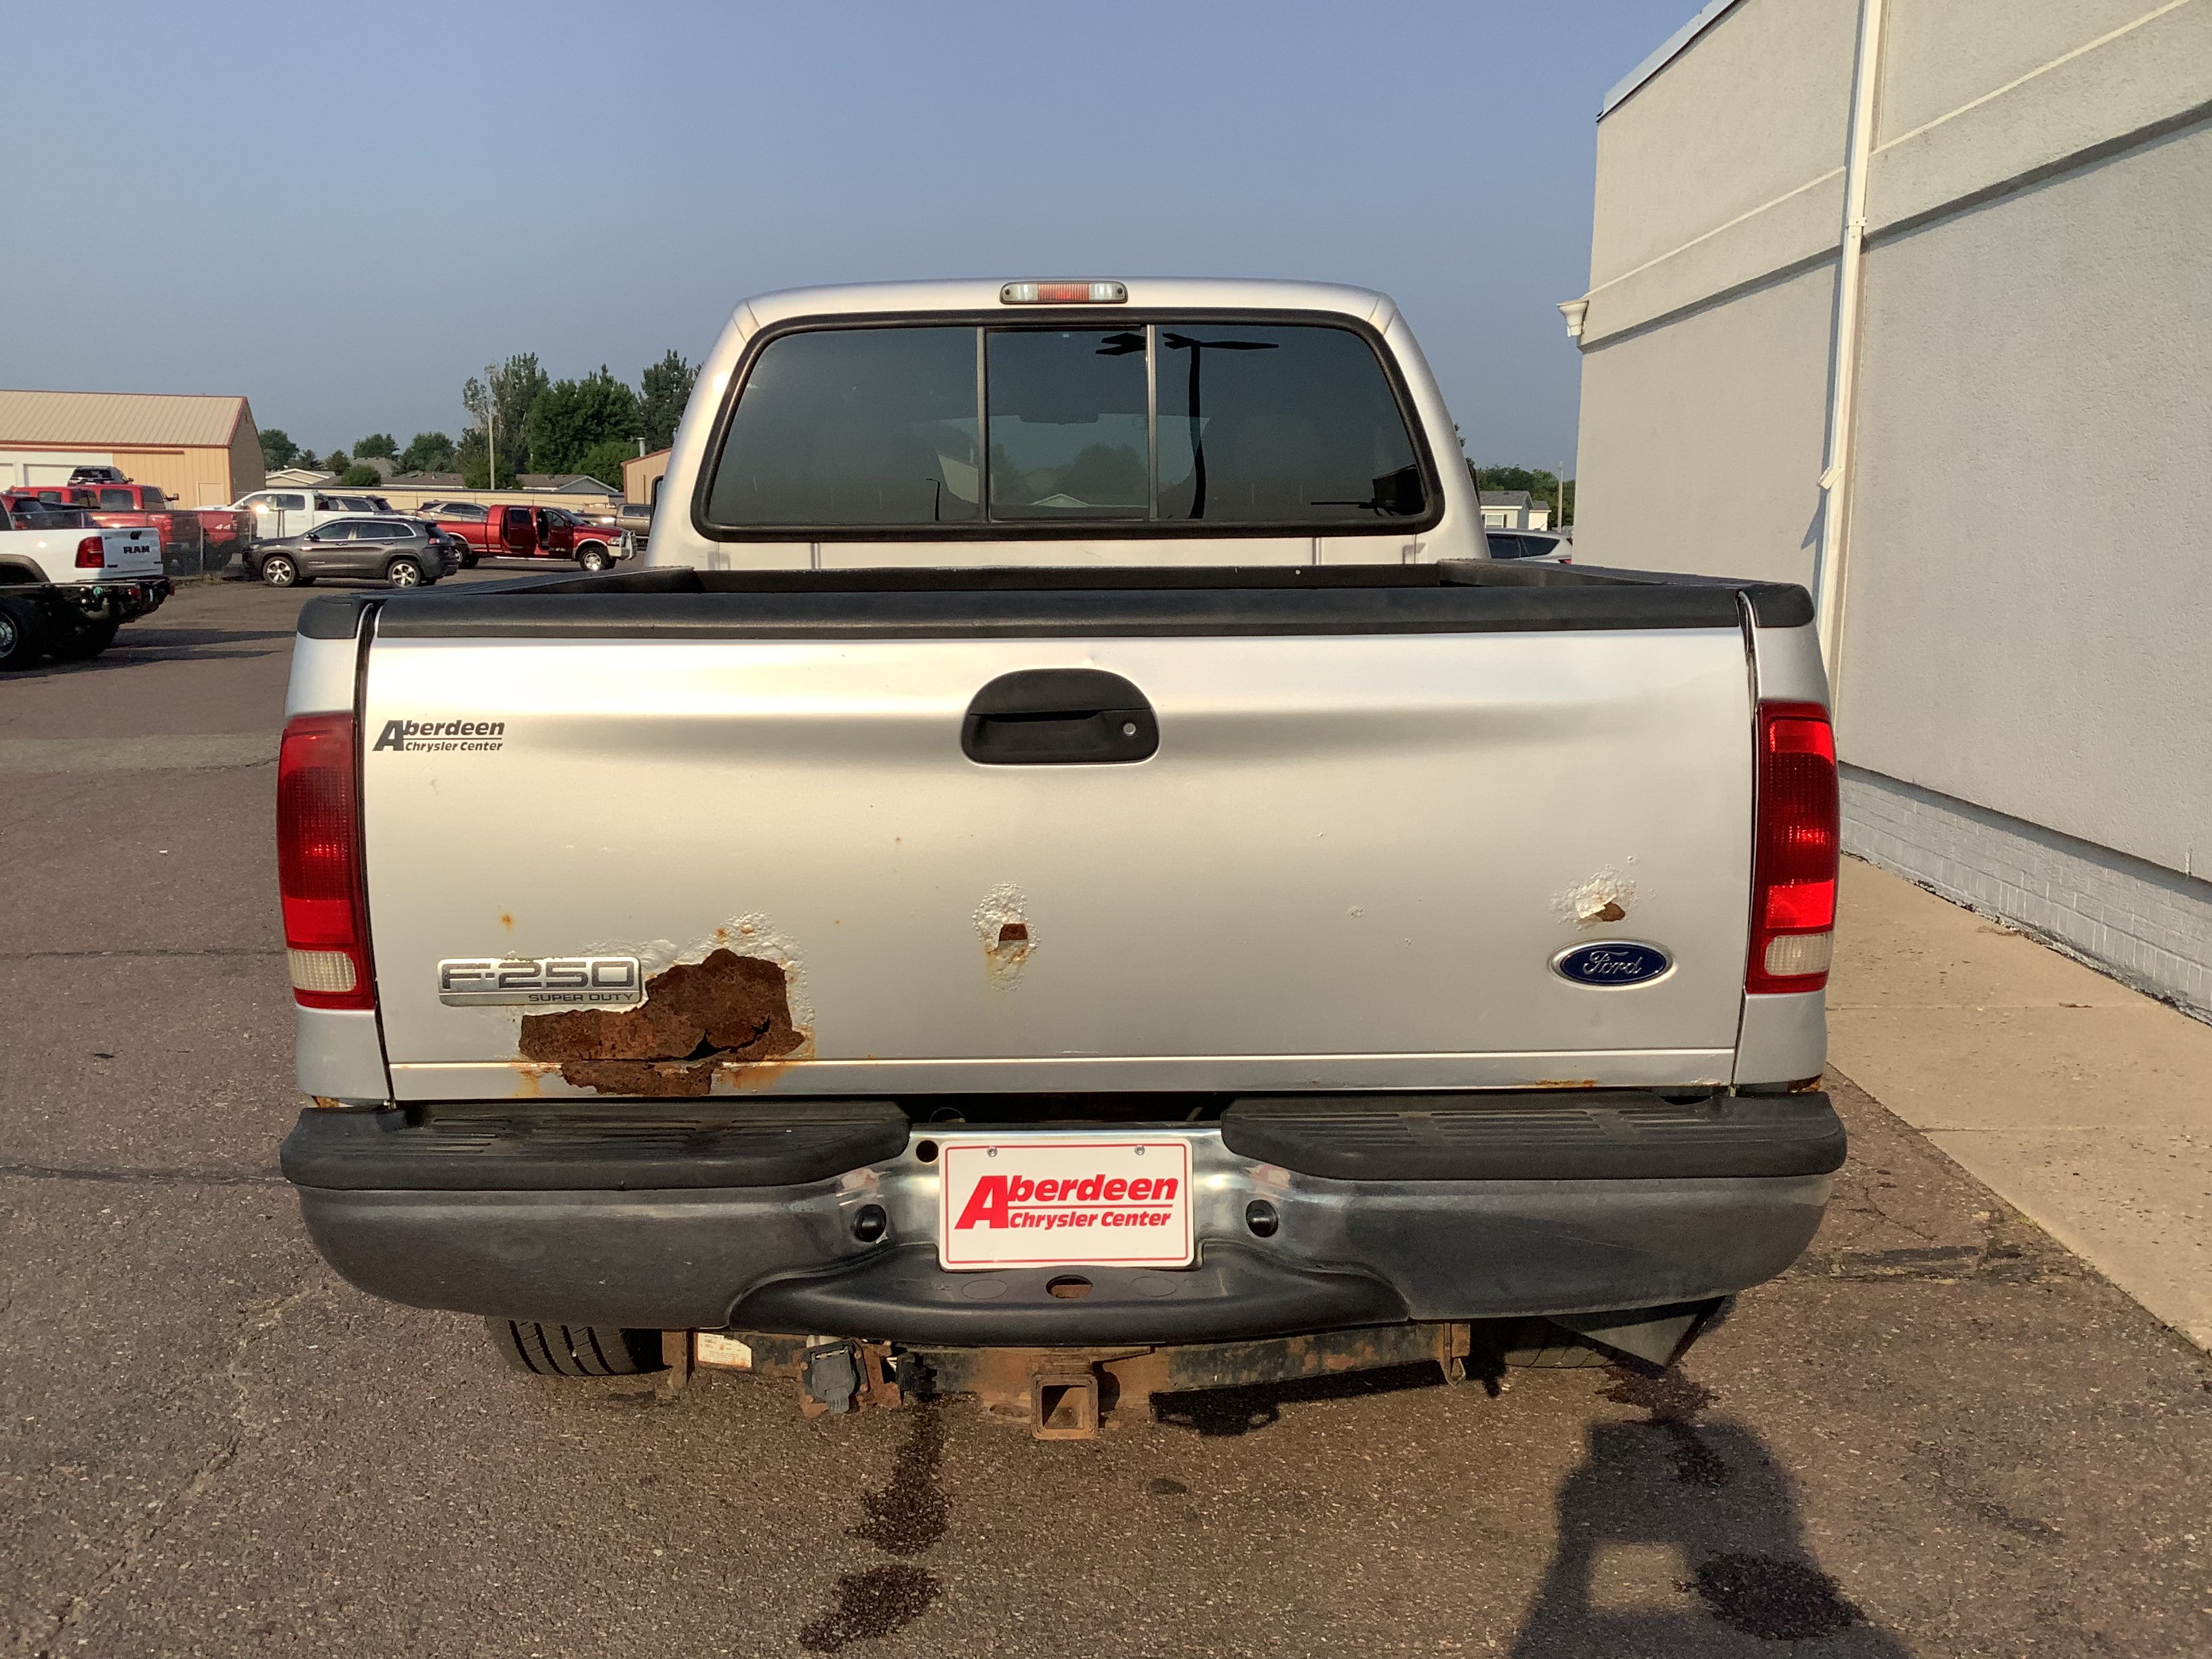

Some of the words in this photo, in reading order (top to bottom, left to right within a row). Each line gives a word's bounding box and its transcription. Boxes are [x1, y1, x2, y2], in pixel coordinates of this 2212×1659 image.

[123, 546, 150, 554] RAM
[372, 720, 505, 751] Aberdeen
[406, 742, 458, 752] Chrysler
[460, 742, 503, 750] Center
[1582, 950, 1643, 975] Ford
[441, 961, 634, 989] F-250
[589, 993, 633, 1001] DUTY
[954, 1174, 1179, 1229] Aberdeen
[1010, 1211, 1099, 1230] Chrysler
[1101, 1210, 1171, 1227] Center
